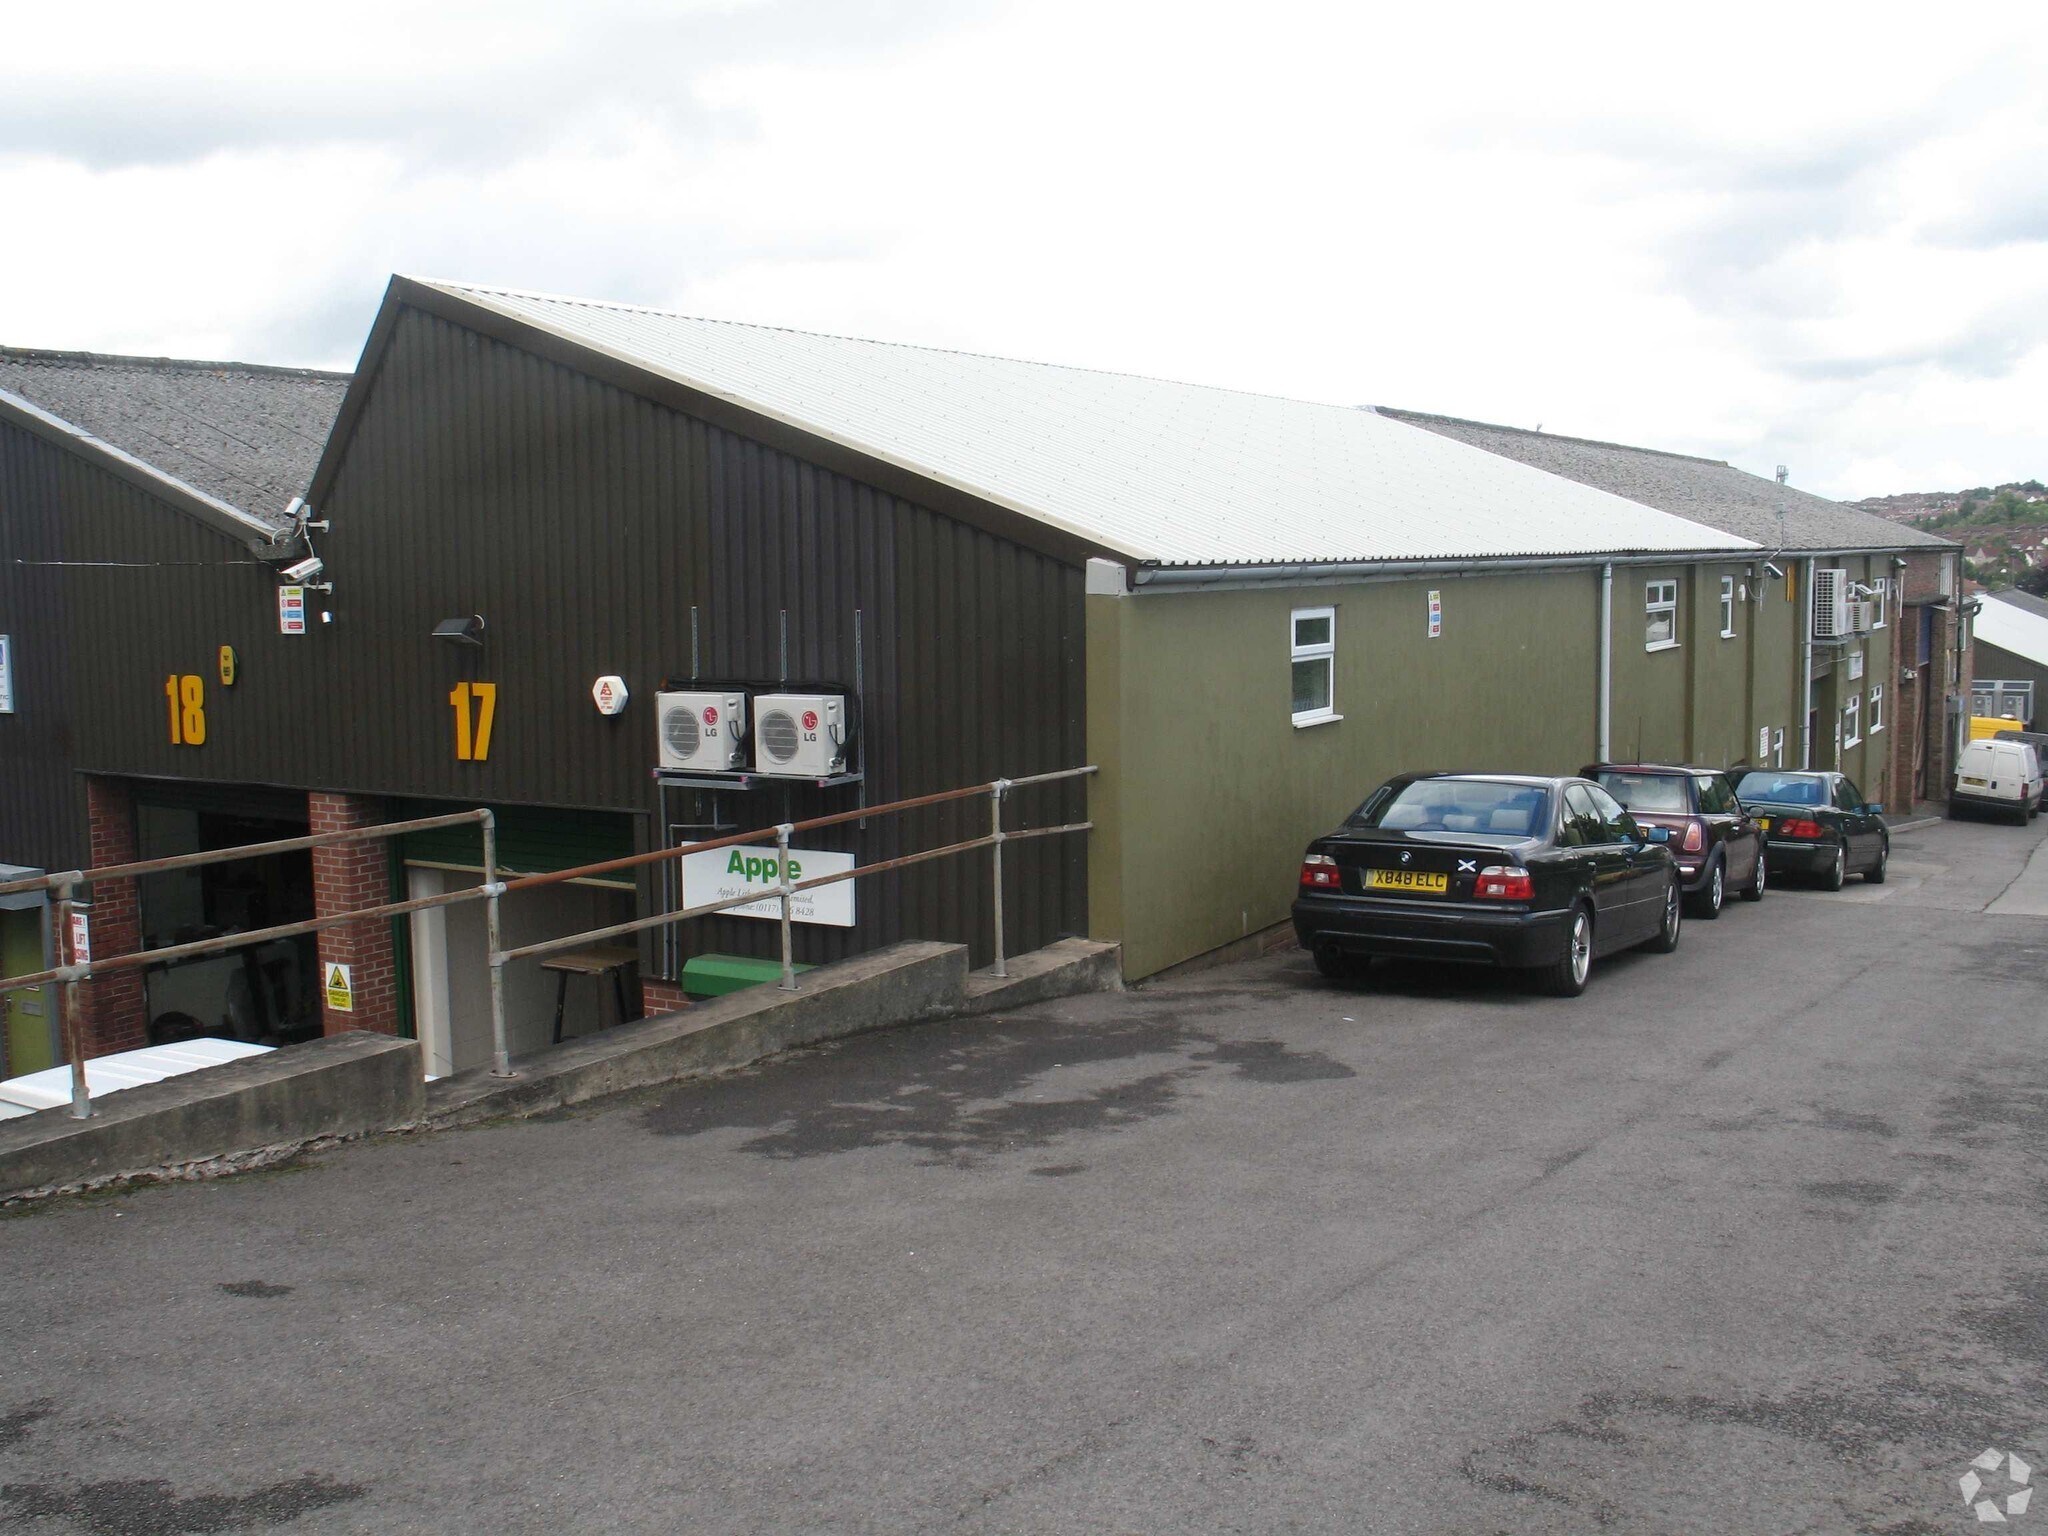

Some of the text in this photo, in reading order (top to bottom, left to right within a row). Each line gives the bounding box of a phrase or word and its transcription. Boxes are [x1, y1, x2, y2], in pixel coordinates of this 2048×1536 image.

[166, 674, 206, 745] 18
[450, 682, 496, 760] 17
[705, 728, 717, 737] LG
[804, 733, 816, 742] LG
[727, 850, 802, 883] Appe
[1416, 873, 1444, 887] ELC
[717, 887, 736, 899] Apple
[796, 907, 815, 916] 8428
